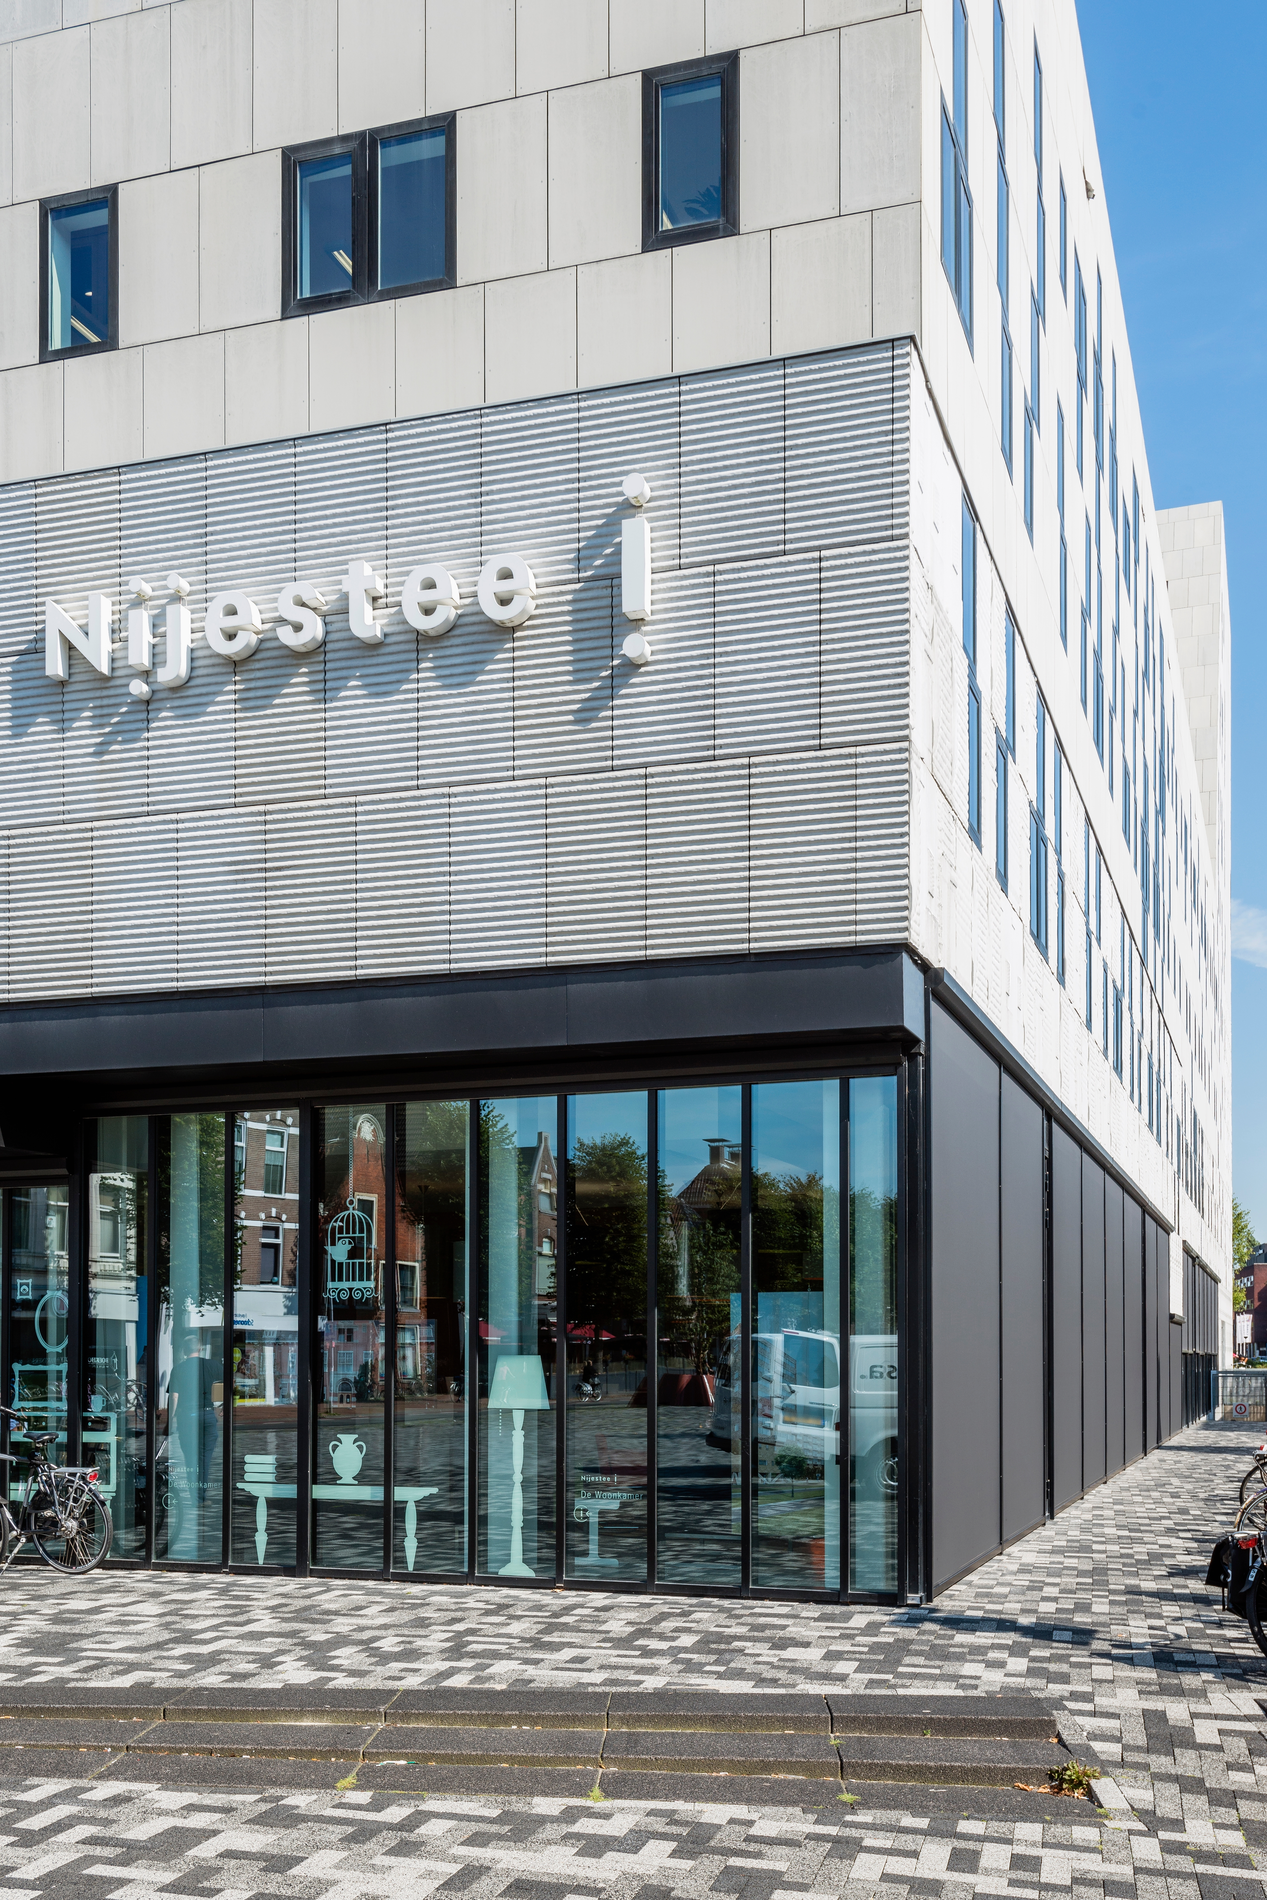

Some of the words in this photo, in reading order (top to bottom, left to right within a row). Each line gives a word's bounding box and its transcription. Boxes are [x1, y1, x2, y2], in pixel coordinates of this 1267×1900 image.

[44, 553, 537, 701] Nijestee
[580, 1475, 611, 1483] Nijestee
[168, 1480, 177, 1488] De
[580, 1490, 592, 1499] De
[594, 1490, 644, 1500] Woonkamer
